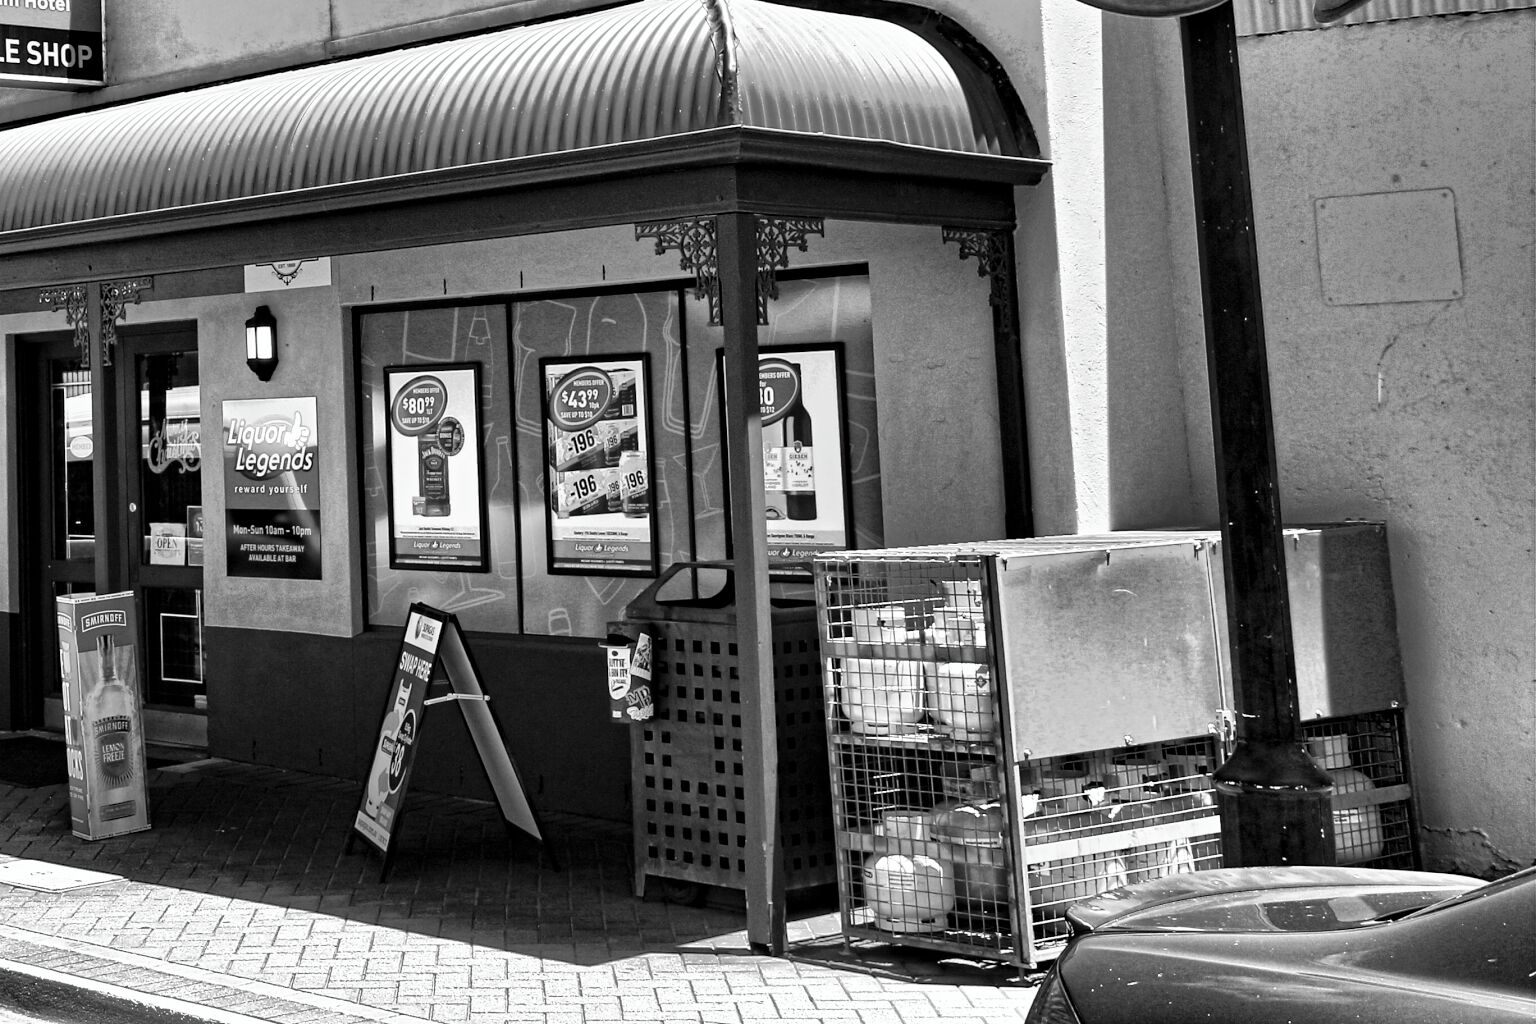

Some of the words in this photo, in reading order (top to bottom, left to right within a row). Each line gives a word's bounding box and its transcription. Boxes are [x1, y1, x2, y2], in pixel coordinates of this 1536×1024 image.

[27, 41, 93, 68] SHOP
[227, 419, 286, 451] Liquor
[568, 429, 595, 454] -196
[235, 445, 313, 477] Legends
[234, 484, 265, 494] reward
[269, 484, 308, 495] yourself
[570, 475, 597, 499] -196
[233, 525, 264, 535] Mon-Sun
[265, 525, 284, 535] 10am
[292, 526, 312, 538] 10pm
[157, 538, 178, 549] OPEN
[258, 544, 275, 552] HOURS
[276, 544, 305, 552] TAKEAWAY
[413, 541, 430, 549] Liquor
[439, 541, 461, 550] Legends
[575, 543, 594, 552] Liquor
[604, 544, 629, 553] Legends
[248, 554, 277, 562] AVAILABLE
[85, 613, 123, 628] SMIRNOFF
[399, 651, 419, 674] SWAP
[416, 658, 433, 682] HERE
[95, 721, 128, 735] SMIRNOFF
[102, 743, 125, 754] LEMON
[103, 751, 125, 763] FREEZE
